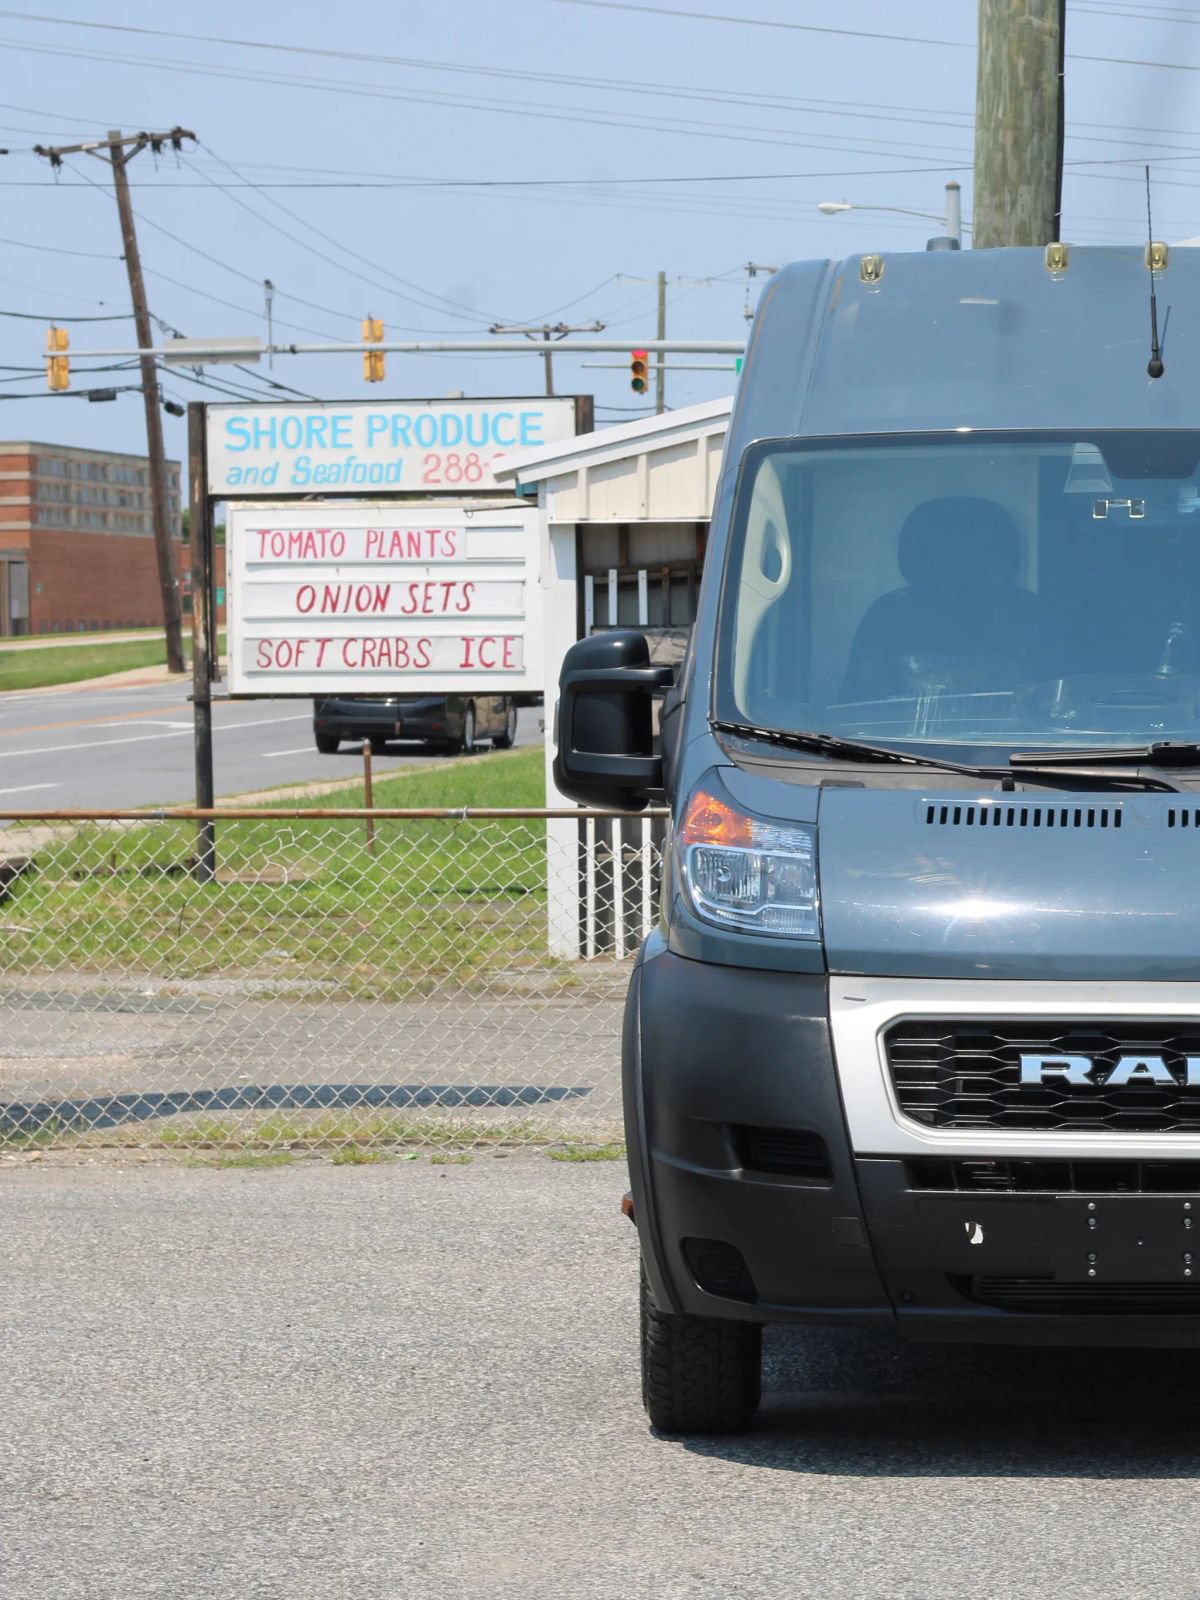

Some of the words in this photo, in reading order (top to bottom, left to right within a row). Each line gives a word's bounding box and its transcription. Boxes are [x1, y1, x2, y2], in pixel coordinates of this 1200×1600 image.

[225, 415, 353, 452] SHORE
[367, 411, 545, 448] PRODUCE
[226, 463, 279, 486] and
[291, 455, 403, 485] Seafood
[422, 453, 506, 484] 288-
[256, 528, 346, 560] TOMATO
[365, 529, 457, 559] PLANTS
[296, 584, 391, 614] ONION
[401, 581, 475, 614] SETS
[256, 638, 333, 668] SOFT
[342, 637, 432, 668] CRABS
[459, 636, 516, 669] ICE
